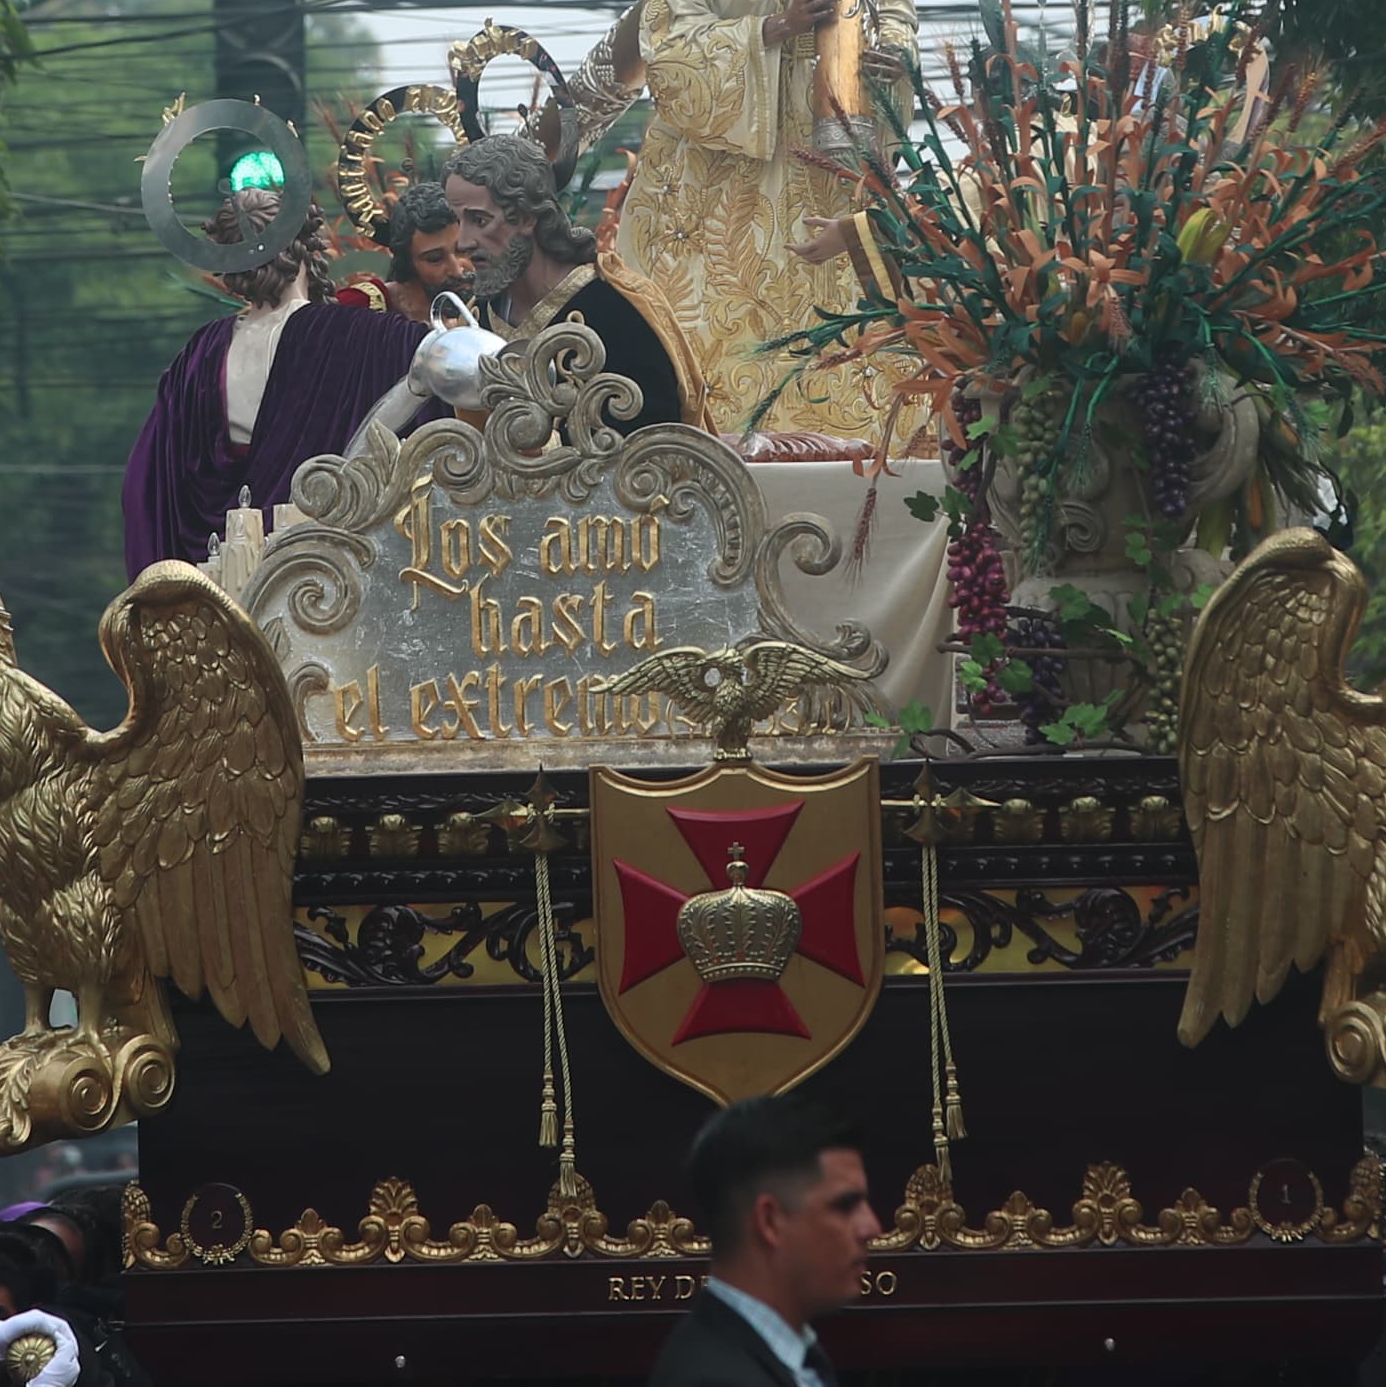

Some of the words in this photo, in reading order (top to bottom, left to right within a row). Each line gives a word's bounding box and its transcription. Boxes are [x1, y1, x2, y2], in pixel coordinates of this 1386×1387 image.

[394, 471, 512, 610] Los
[540, 494, 670, 574] amó
[468, 573, 663, 658] hasta
[333, 663, 390, 741] el
[212, 1210, 222, 1229] 2
[608, 1276, 666, 1301] REY
